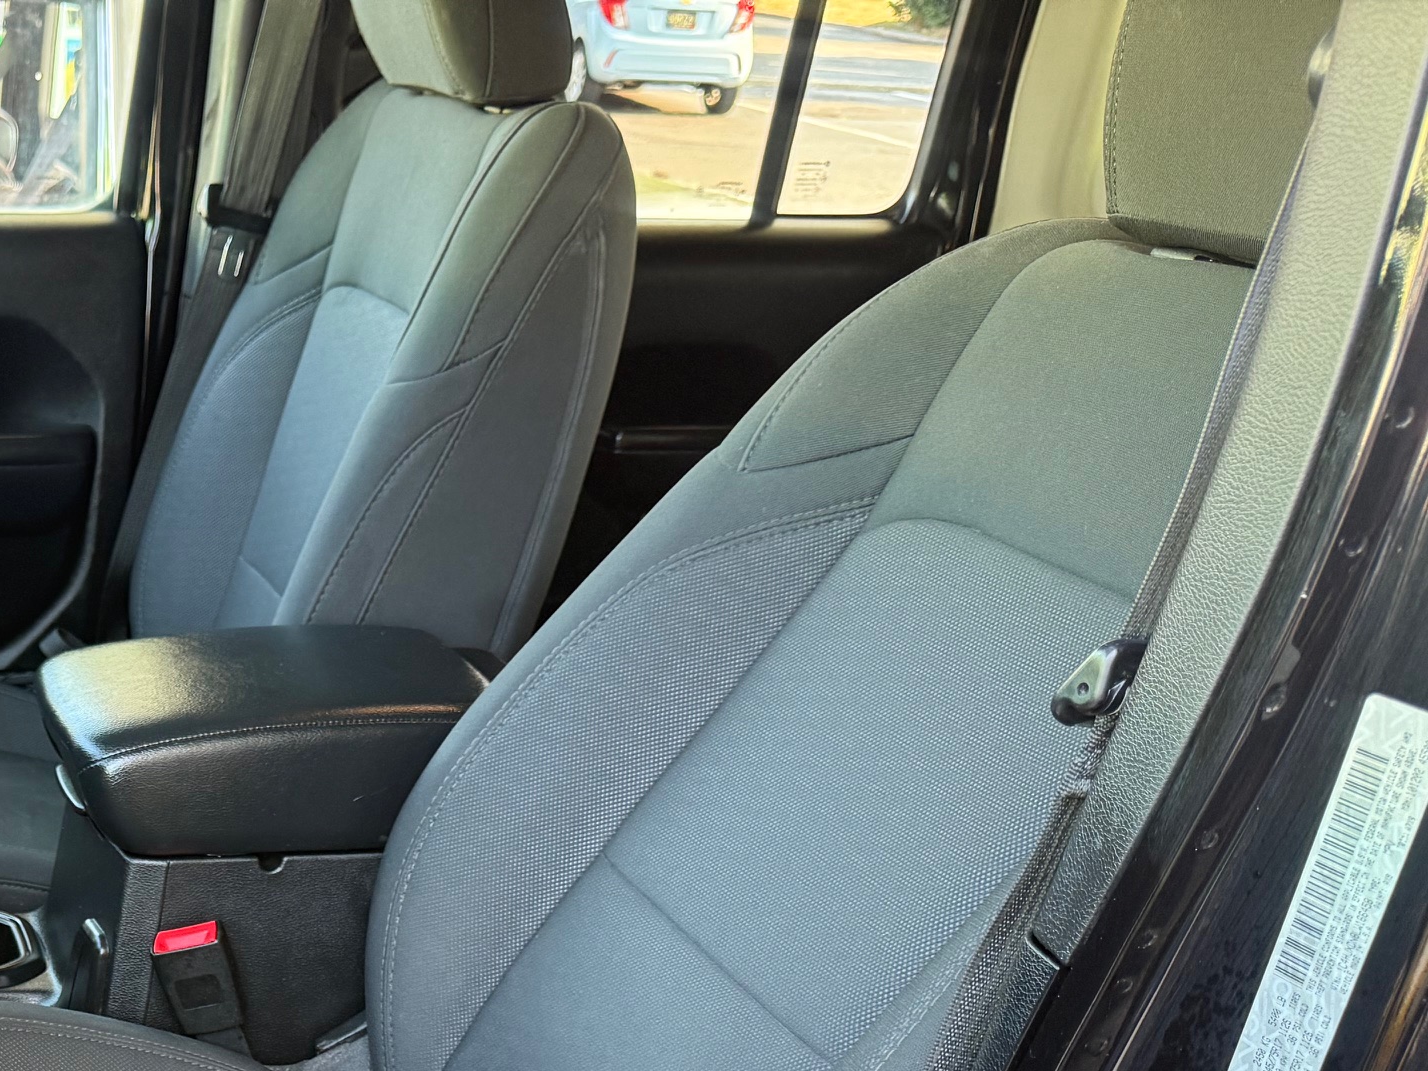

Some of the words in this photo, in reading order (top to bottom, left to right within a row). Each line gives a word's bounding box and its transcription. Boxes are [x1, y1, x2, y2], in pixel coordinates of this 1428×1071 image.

[1392, 744, 1408, 767] SAFETY
[1381, 767, 1399, 796] VEHICLE
[1395, 769, 1410, 790] SHOWN
[1379, 789, 1402, 830] MANUFACTURE
[1375, 830, 1386, 840] OF
[1368, 840, 1382, 857] DATE
[1363, 856, 1375, 870] THE
[1350, 880, 1366, 903] EFFECT
[1334, 912, 1353, 945] STANDARDS
[1310, 952, 1326, 978] VEHICLE
[1321, 943, 1341, 980] PREVENTION
[1304, 977, 1317, 993] THIS
[1274, 994, 1287, 1007] LB
[1267, 1006, 1282, 1028] 5400
[1277, 1016, 1292, 1037] 112S
[1288, 990, 1301, 1010] TIRES
[1298, 1028, 1314, 1050] 112S
[1309, 1002, 1323, 1022] TIRES
[1259, 1034, 1271, 1047] KG
[1286, 1033, 1298, 1046] 36
[1251, 1046, 1266, 1067] 2450
[1307, 1045, 1320, 1058] 36
